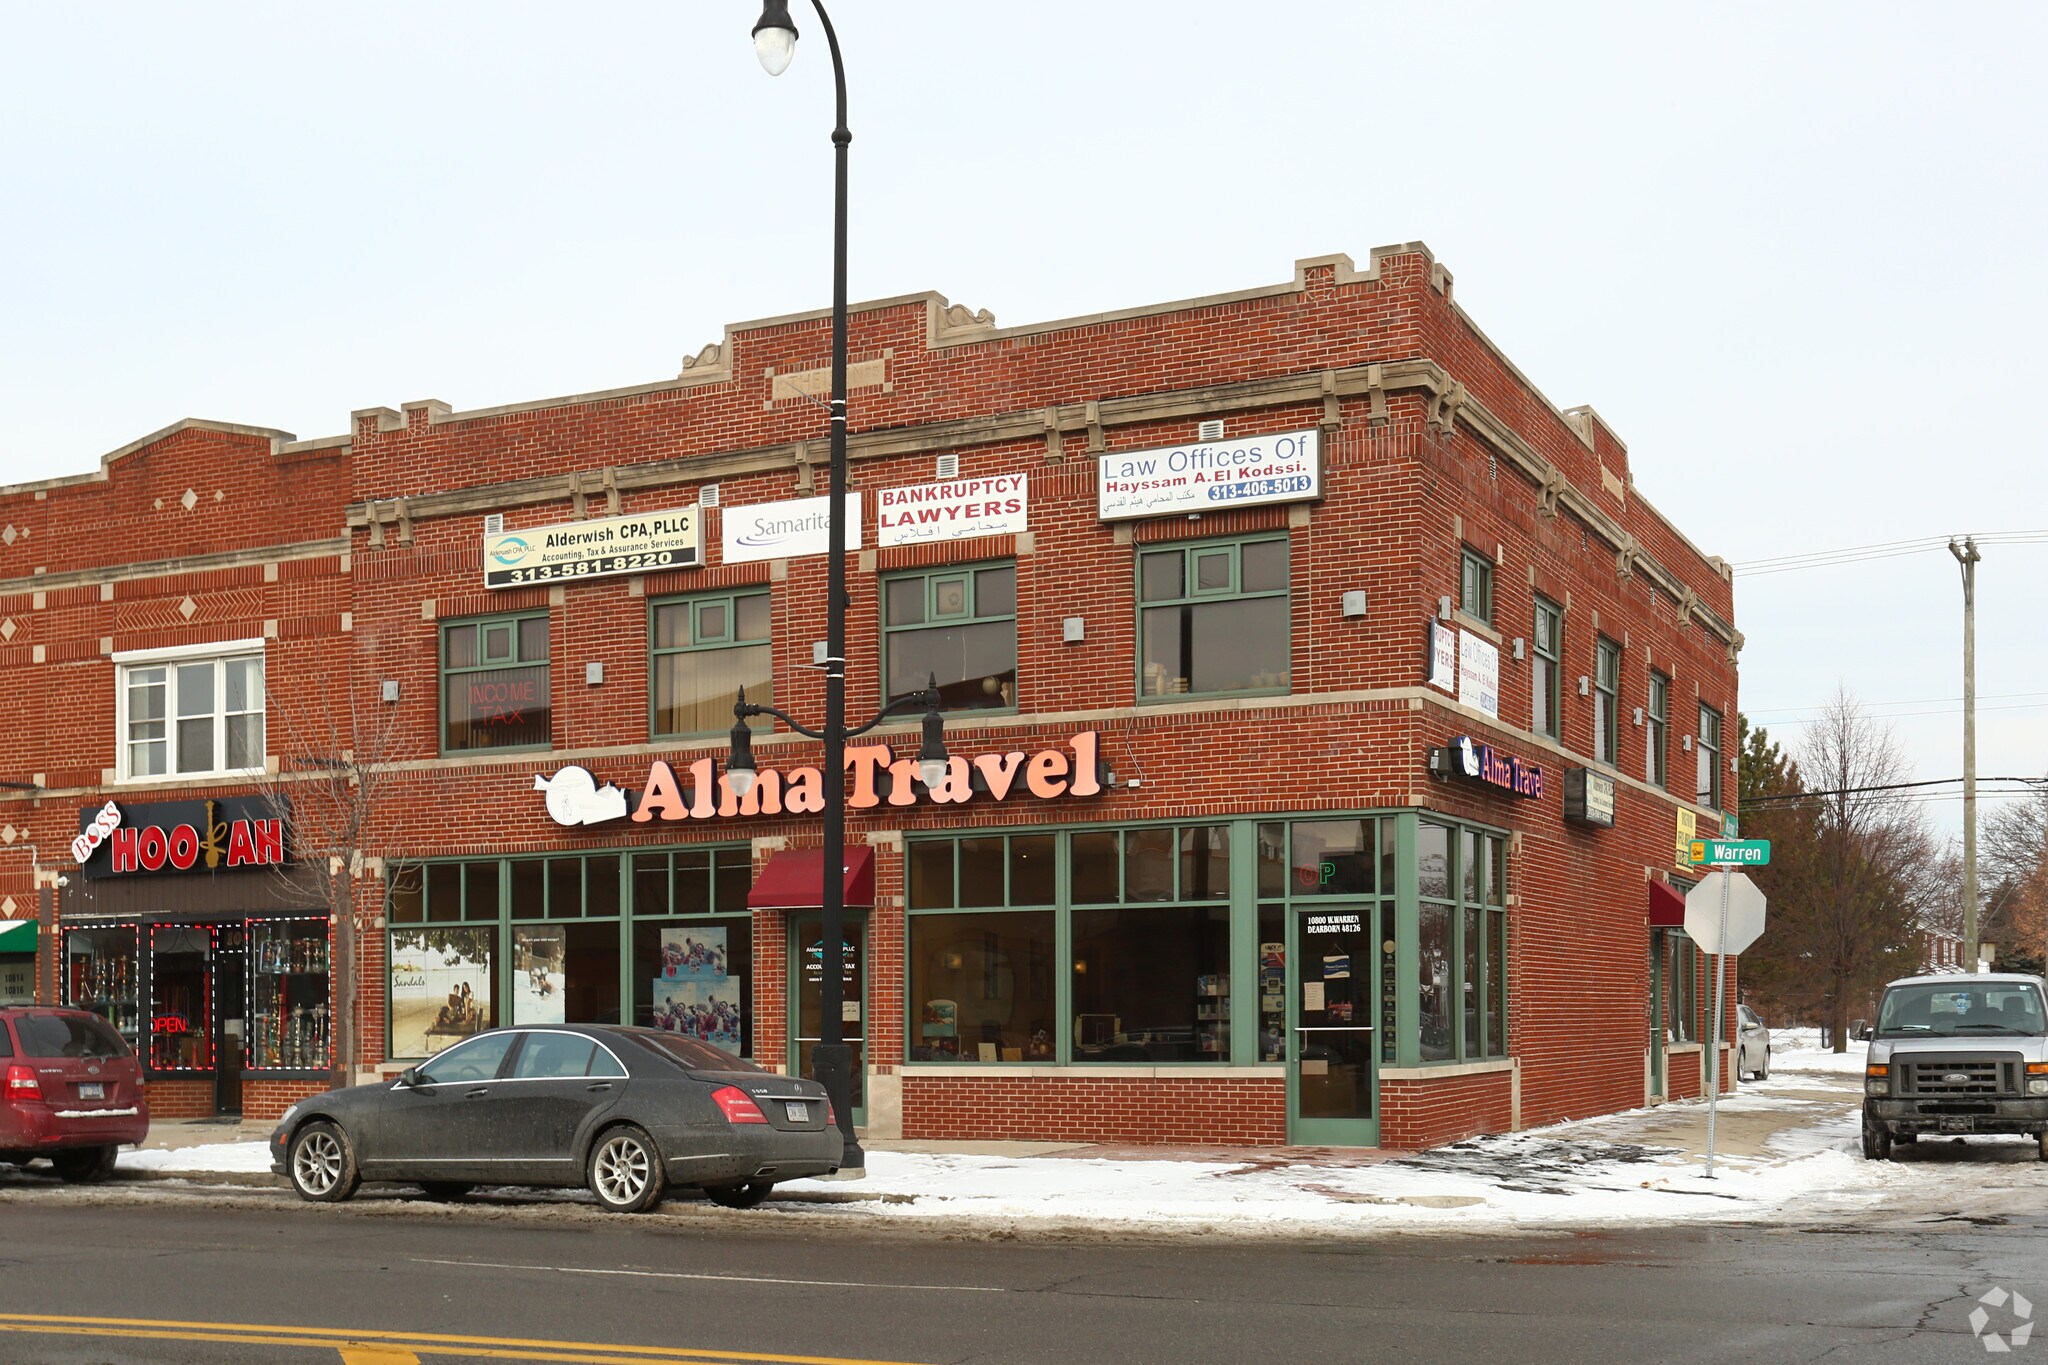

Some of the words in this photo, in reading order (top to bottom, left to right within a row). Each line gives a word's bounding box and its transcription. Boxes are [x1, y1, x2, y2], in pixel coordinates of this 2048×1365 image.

[1104, 458, 1157, 479] Law
[1168, 446, 1263, 473] Offices
[1275, 435, 1308, 459] Of
[882, 475, 1023, 507] BANKRUPTCY
[1106, 476, 1187, 494] Hayssam
[1211, 477, 1309, 500] 313-406-5013
[753, 510, 831, 538] Samarita
[880, 499, 1022, 528] LAWYERS
[546, 527, 614, 548] Alderwish
[541, 550, 585, 562] Accounting,
[586, 547, 599, 557] Tax
[600, 546, 606, 555] &
[609, 541, 648, 554] Assurance
[650, 538, 684, 548] Services
[510, 551, 673, 584] 313-581-8220
[469, 680, 537, 705] INCOME
[478, 704, 525, 728] TAX
[631, 757, 826, 823] Alma
[844, 730, 1101, 809] Travel
[1481, 744, 1511, 790] Alma
[1513, 756, 1544, 800] Travel
[74, 804, 120, 860] BOSS
[1713, 844, 1761, 861] Warren
[1307, 916, 1326, 925] 10800
[1307, 925, 1341, 934] DEARBORN
[1341, 924, 1361, 933] 48126
[394, 975, 425, 988] Sandals
[151, 1016, 187, 1033] OPEN
